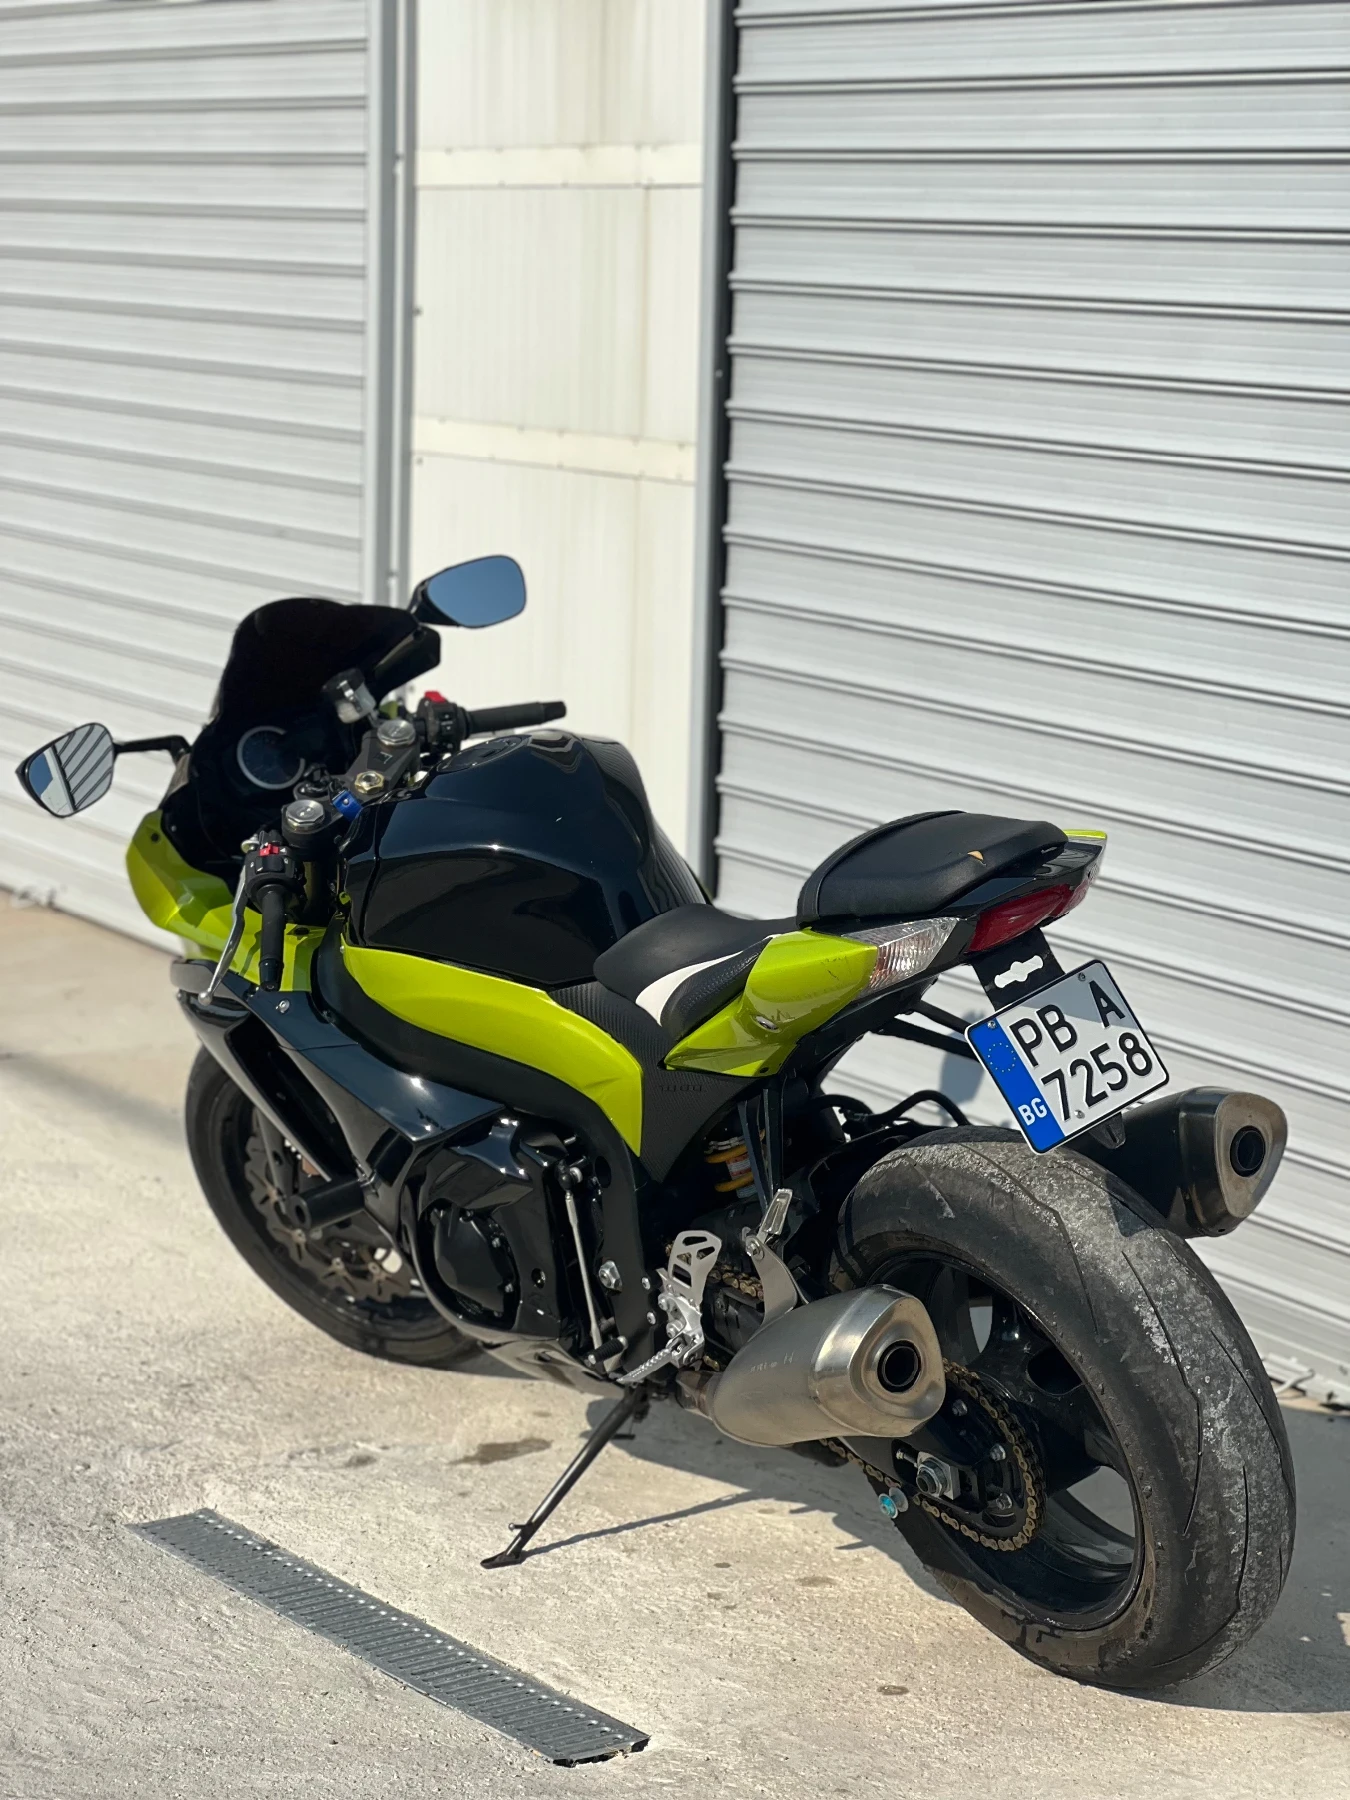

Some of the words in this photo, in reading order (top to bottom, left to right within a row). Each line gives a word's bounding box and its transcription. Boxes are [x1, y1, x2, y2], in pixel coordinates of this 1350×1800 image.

[1009, 1005, 1078, 1067] PB
[1089, 980, 1126, 1028] A
[1018, 1097, 1048, 1126] BG
[1041, 1032, 1153, 1122] 7258
